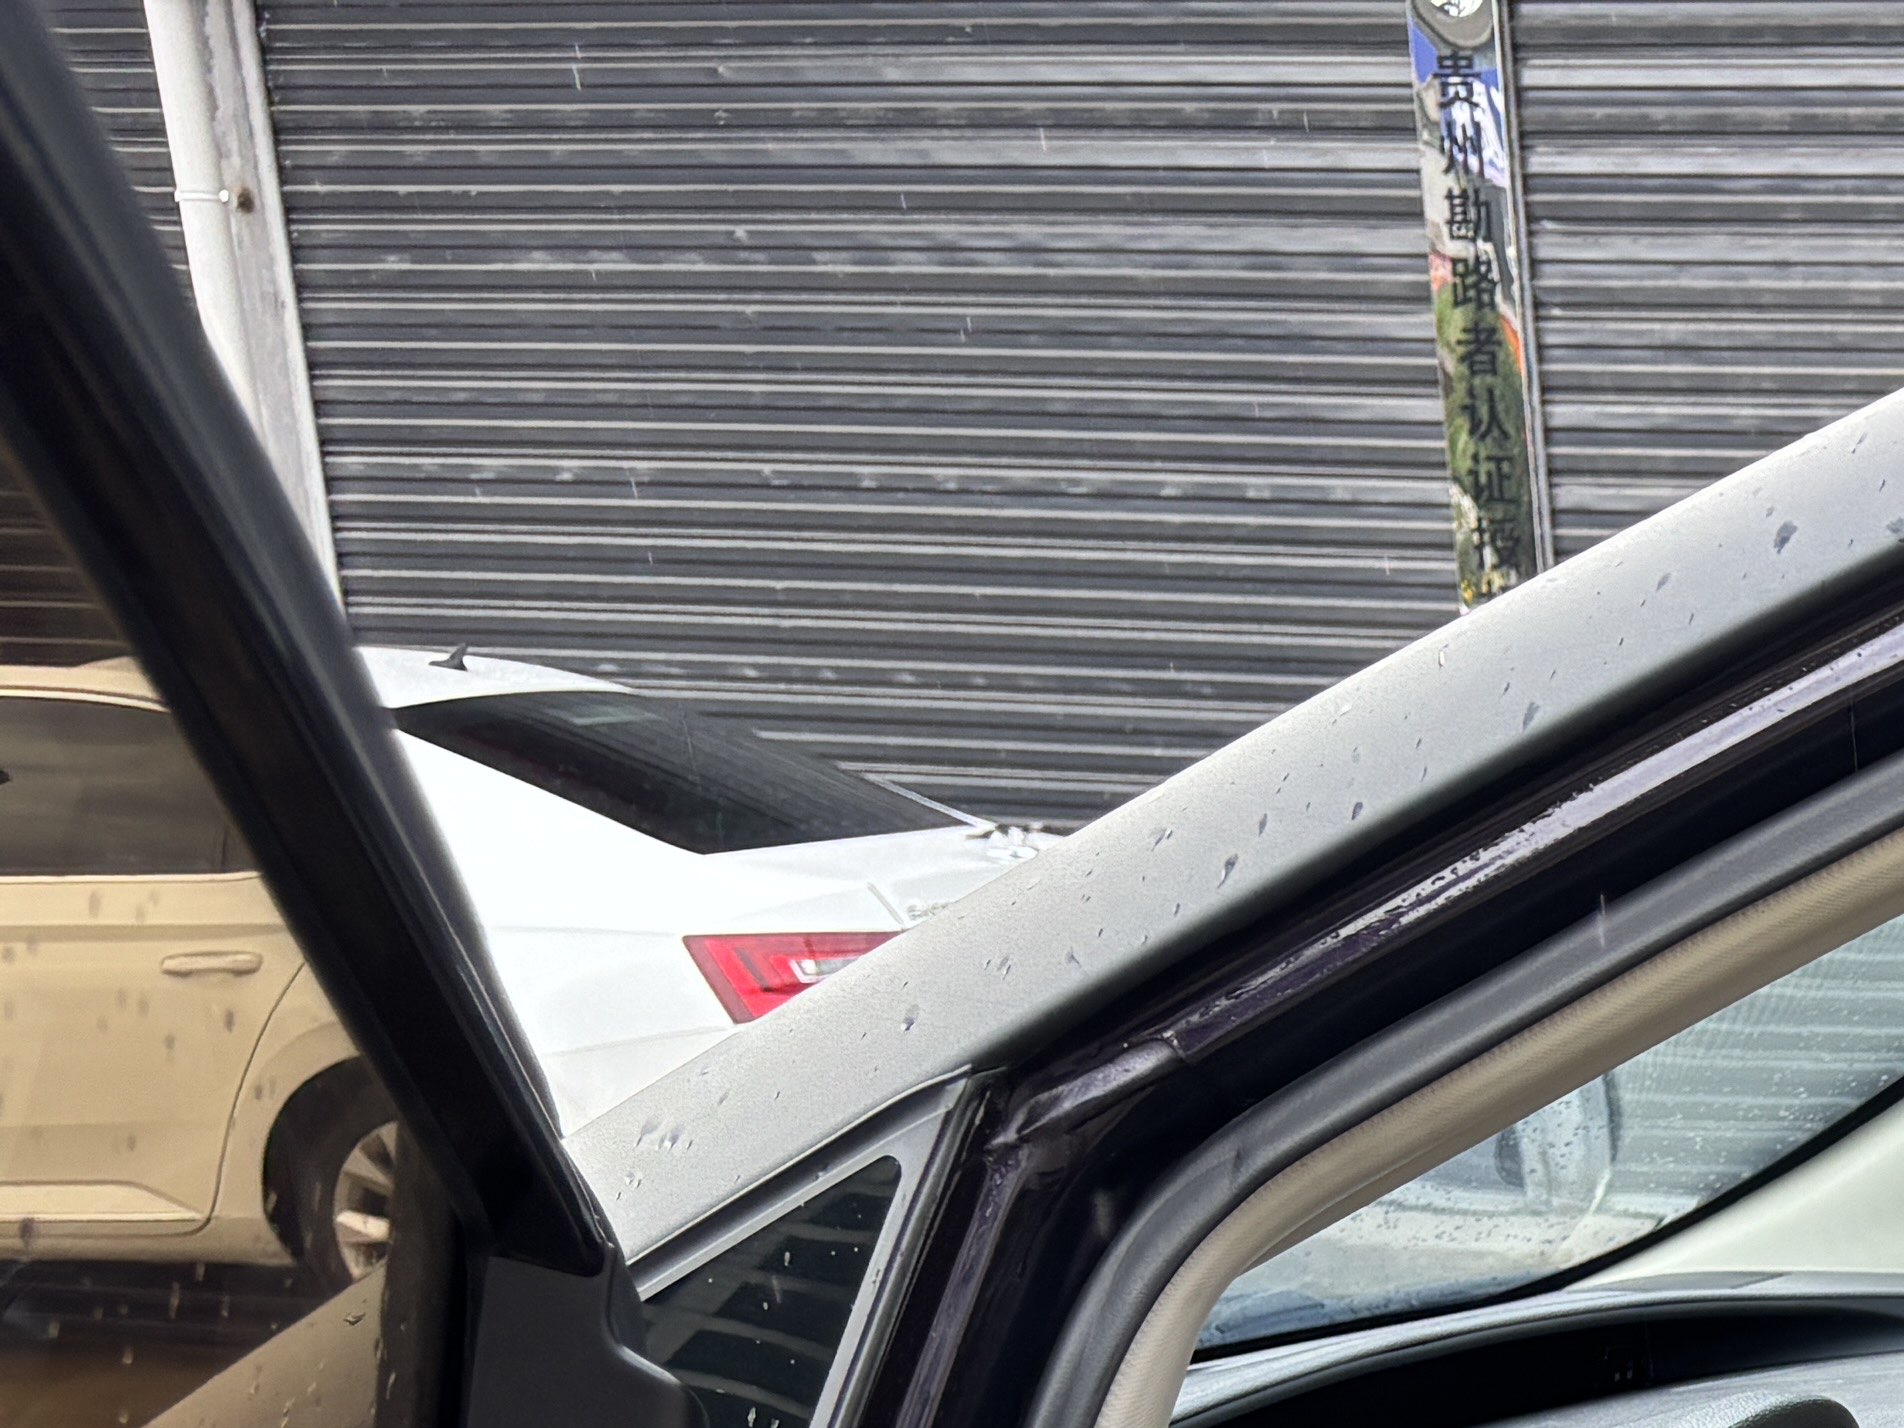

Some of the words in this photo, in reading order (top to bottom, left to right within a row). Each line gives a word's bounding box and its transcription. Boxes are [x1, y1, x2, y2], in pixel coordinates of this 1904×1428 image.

[1433, 50, 1520, 600] 贵州勘路者认证授
